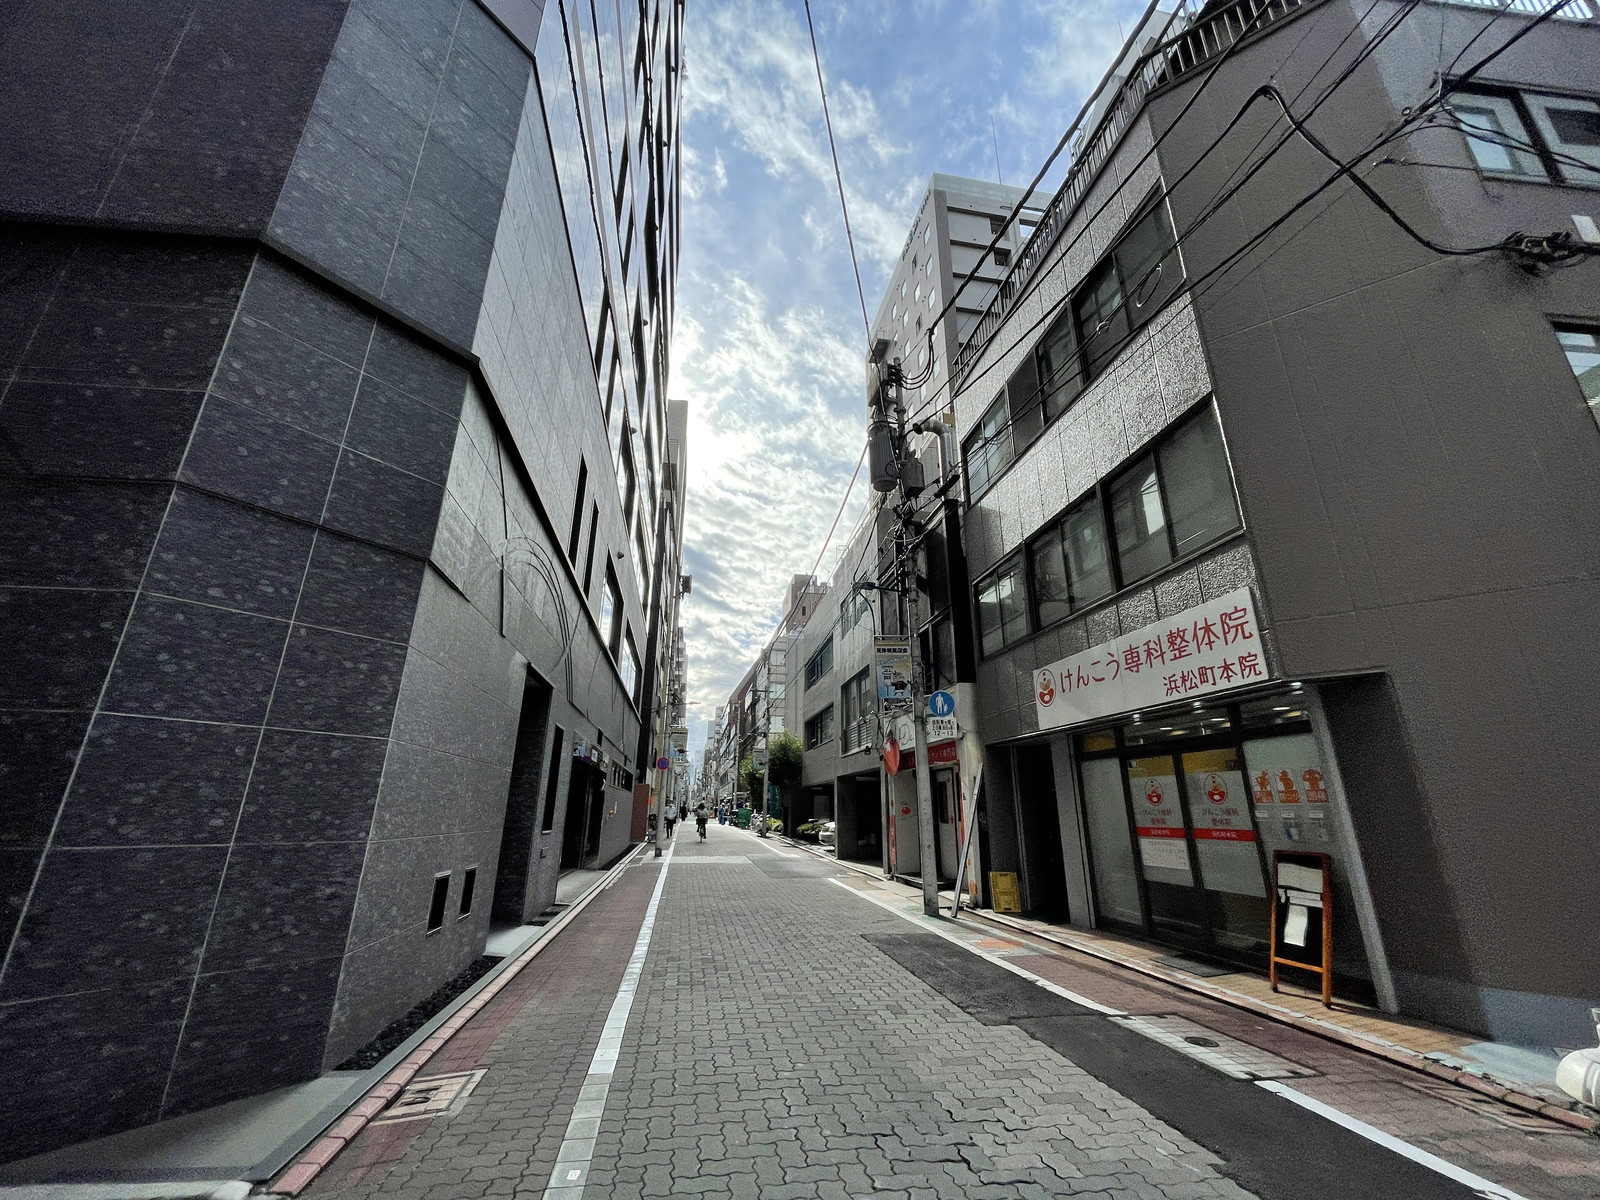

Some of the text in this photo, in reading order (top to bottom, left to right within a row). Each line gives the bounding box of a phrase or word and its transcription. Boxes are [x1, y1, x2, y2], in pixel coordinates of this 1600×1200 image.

[1060, 605, 1254, 693] けんこう専科整体院
[1163, 652, 1262, 697] 浜松町本院
